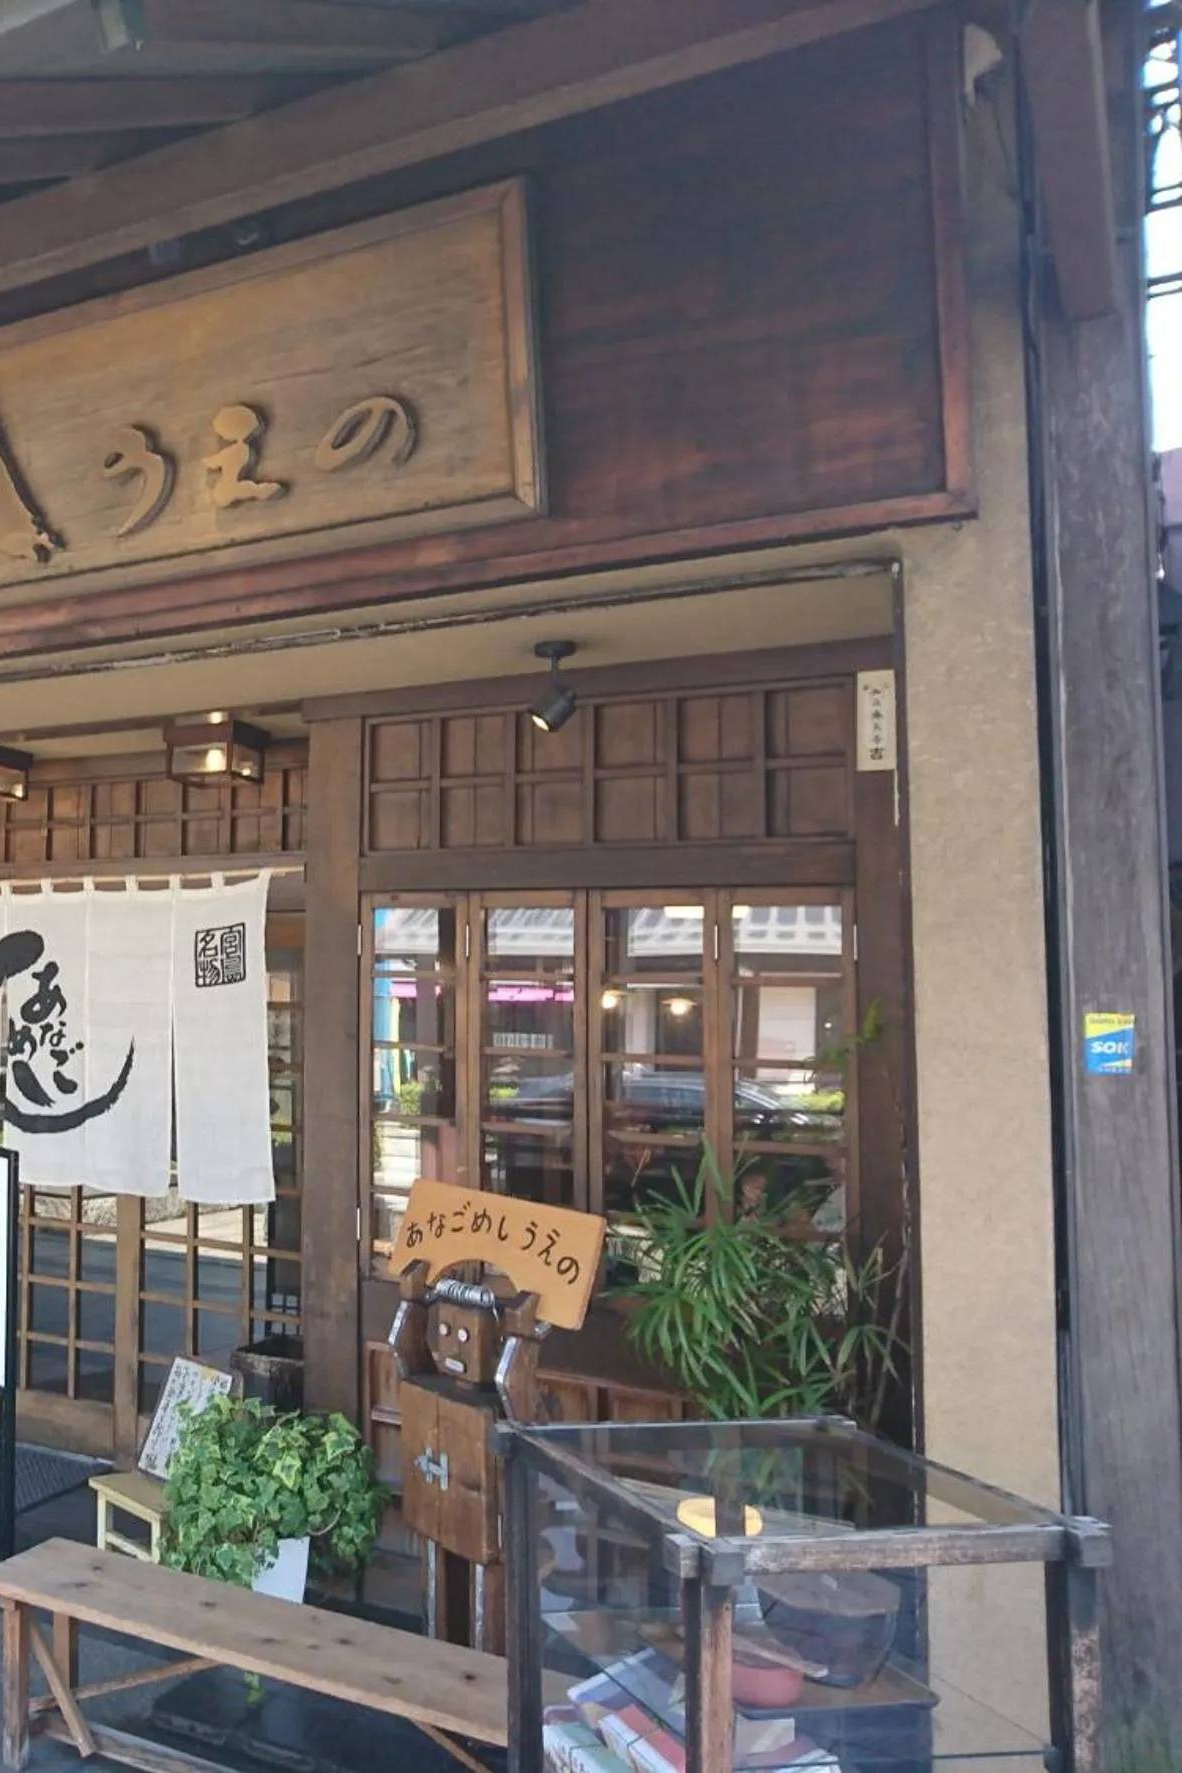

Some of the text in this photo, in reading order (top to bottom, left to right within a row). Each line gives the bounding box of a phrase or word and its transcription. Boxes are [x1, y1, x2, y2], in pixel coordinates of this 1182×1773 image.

[103, 394, 418, 537] うえの
[406, 1201, 581, 1285] あなごめし うえの
